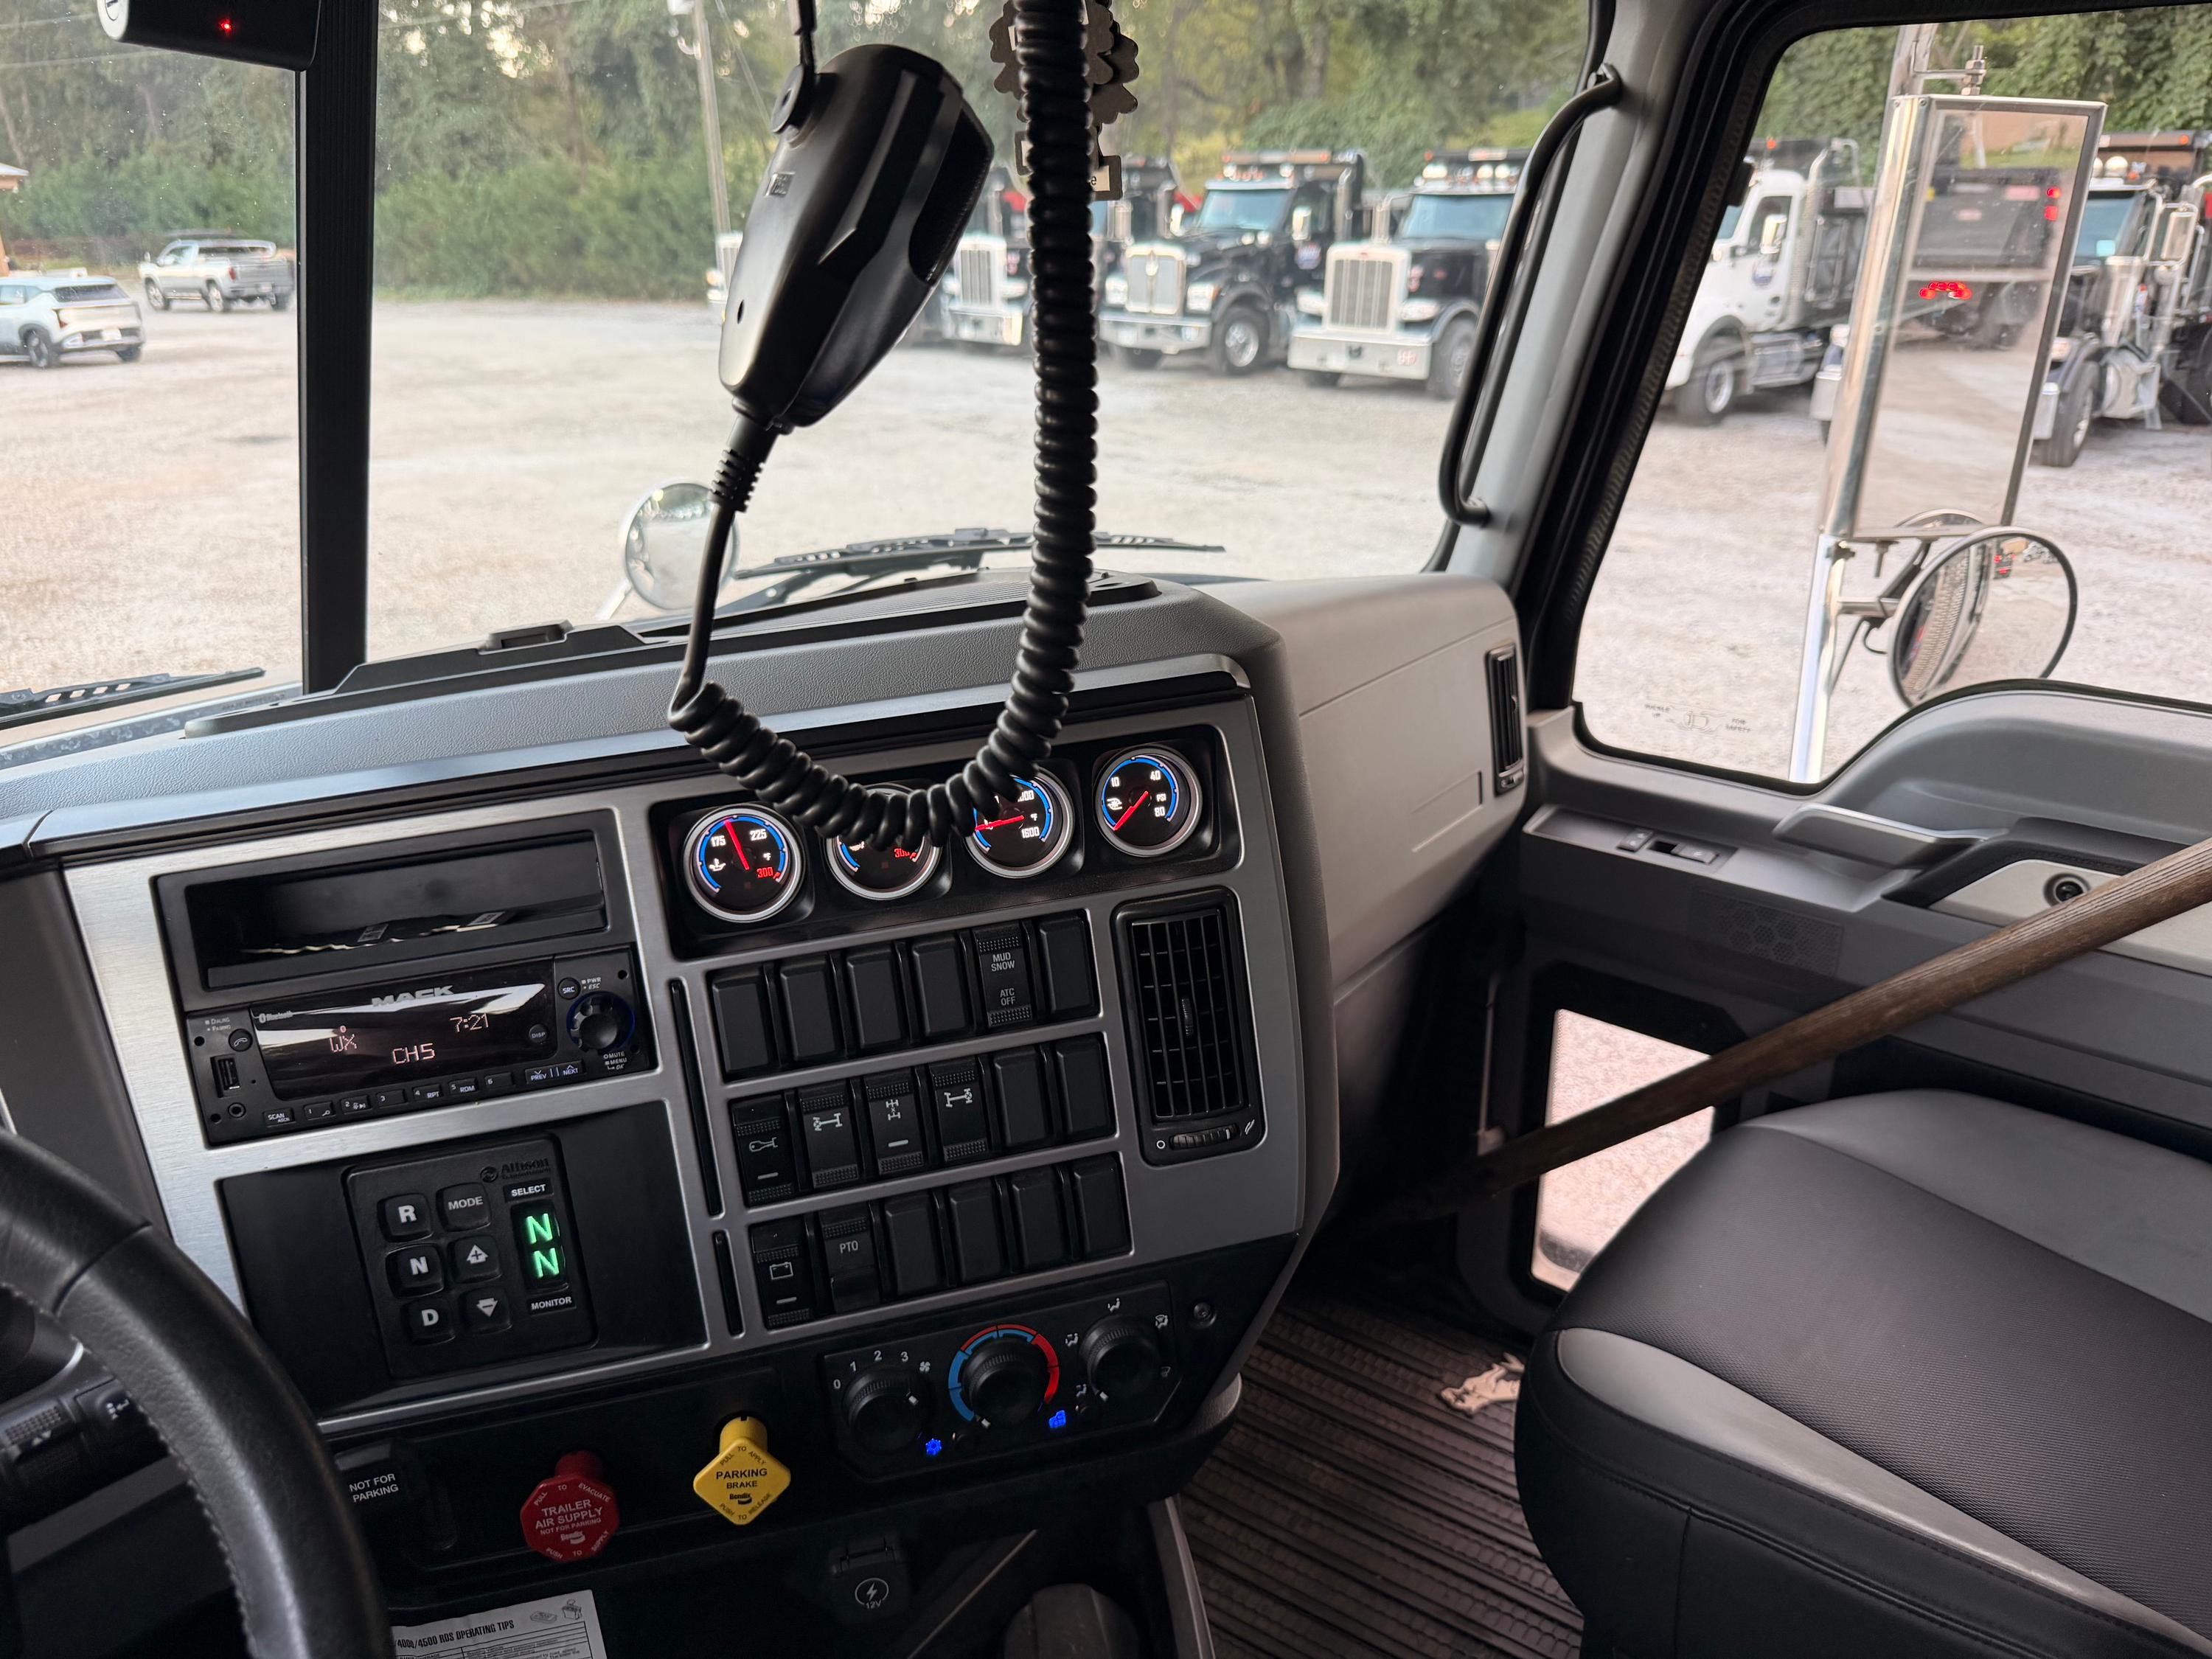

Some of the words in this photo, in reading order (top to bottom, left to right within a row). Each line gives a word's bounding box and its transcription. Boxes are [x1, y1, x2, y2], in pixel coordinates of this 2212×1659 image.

[1111, 776, 1119, 787] 10
[1150, 770, 1161, 781] 40
[1156, 793, 1166, 801] PSI
[1155, 807, 1165, 817] 80
[750, 829, 767, 841] 225
[1021, 827, 1040, 838] 1600
[711, 835, 726, 846] 175
[757, 867, 773, 877] 300
[992, 953, 1011, 962] MUD
[991, 960, 1015, 972] SNOW
[372, 985, 453, 1006] MACK
[1000, 988, 1015, 998] ATC
[1001, 996, 1015, 1006] OFF
[450, 1013, 488, 1032] 7:21
[330, 1034, 357, 1052] WX
[392, 1043, 435, 1064] CH5
[511, 1184, 546, 1197] SELECT
[448, 1196, 484, 1210] MODE
[398, 1205, 417, 1223] R
[526, 1213, 553, 1244] N
[840, 1240, 858, 1253] PTO
[410, 1256, 428, 1276] N
[534, 1248, 560, 1278] N
[531, 1296, 572, 1310] MONITOR
[421, 1309, 439, 1326] D
[874, 1350, 882, 1361] 2
[901, 1352, 908, 1362] 3
[850, 1361, 856, 1371] 1
[833, 1379, 841, 1389] 0
[720, 1453, 734, 1466] PULL
[748, 1451, 766, 1464] APPLY
[716, 1468, 767, 1480] PARKING
[349, 1480, 370, 1492] NOT
[373, 1474, 395, 1486] FOR
[726, 1481, 758, 1489] BRAKE
[353, 1484, 399, 1503] PARKING
[534, 1492, 547, 1506] PULL
[578, 1482, 611, 1503] EVACUATE
[542, 1499, 591, 1517] TRAILER
[535, 1518, 554, 1529] AIR
[558, 1507, 602, 1524] SUPPLY
[540, 1527, 554, 1535] NOT
[556, 1524, 570, 1532] FOR
[571, 1517, 601, 1528] PARKING
[546, 1547, 563, 1559] PUSH
[866, 1599, 881, 1609] 12V
[439, 1632, 453, 1643] RDS
[456, 1624, 496, 1640] OPERATING
[497, 1620, 514, 1631] TIPS
